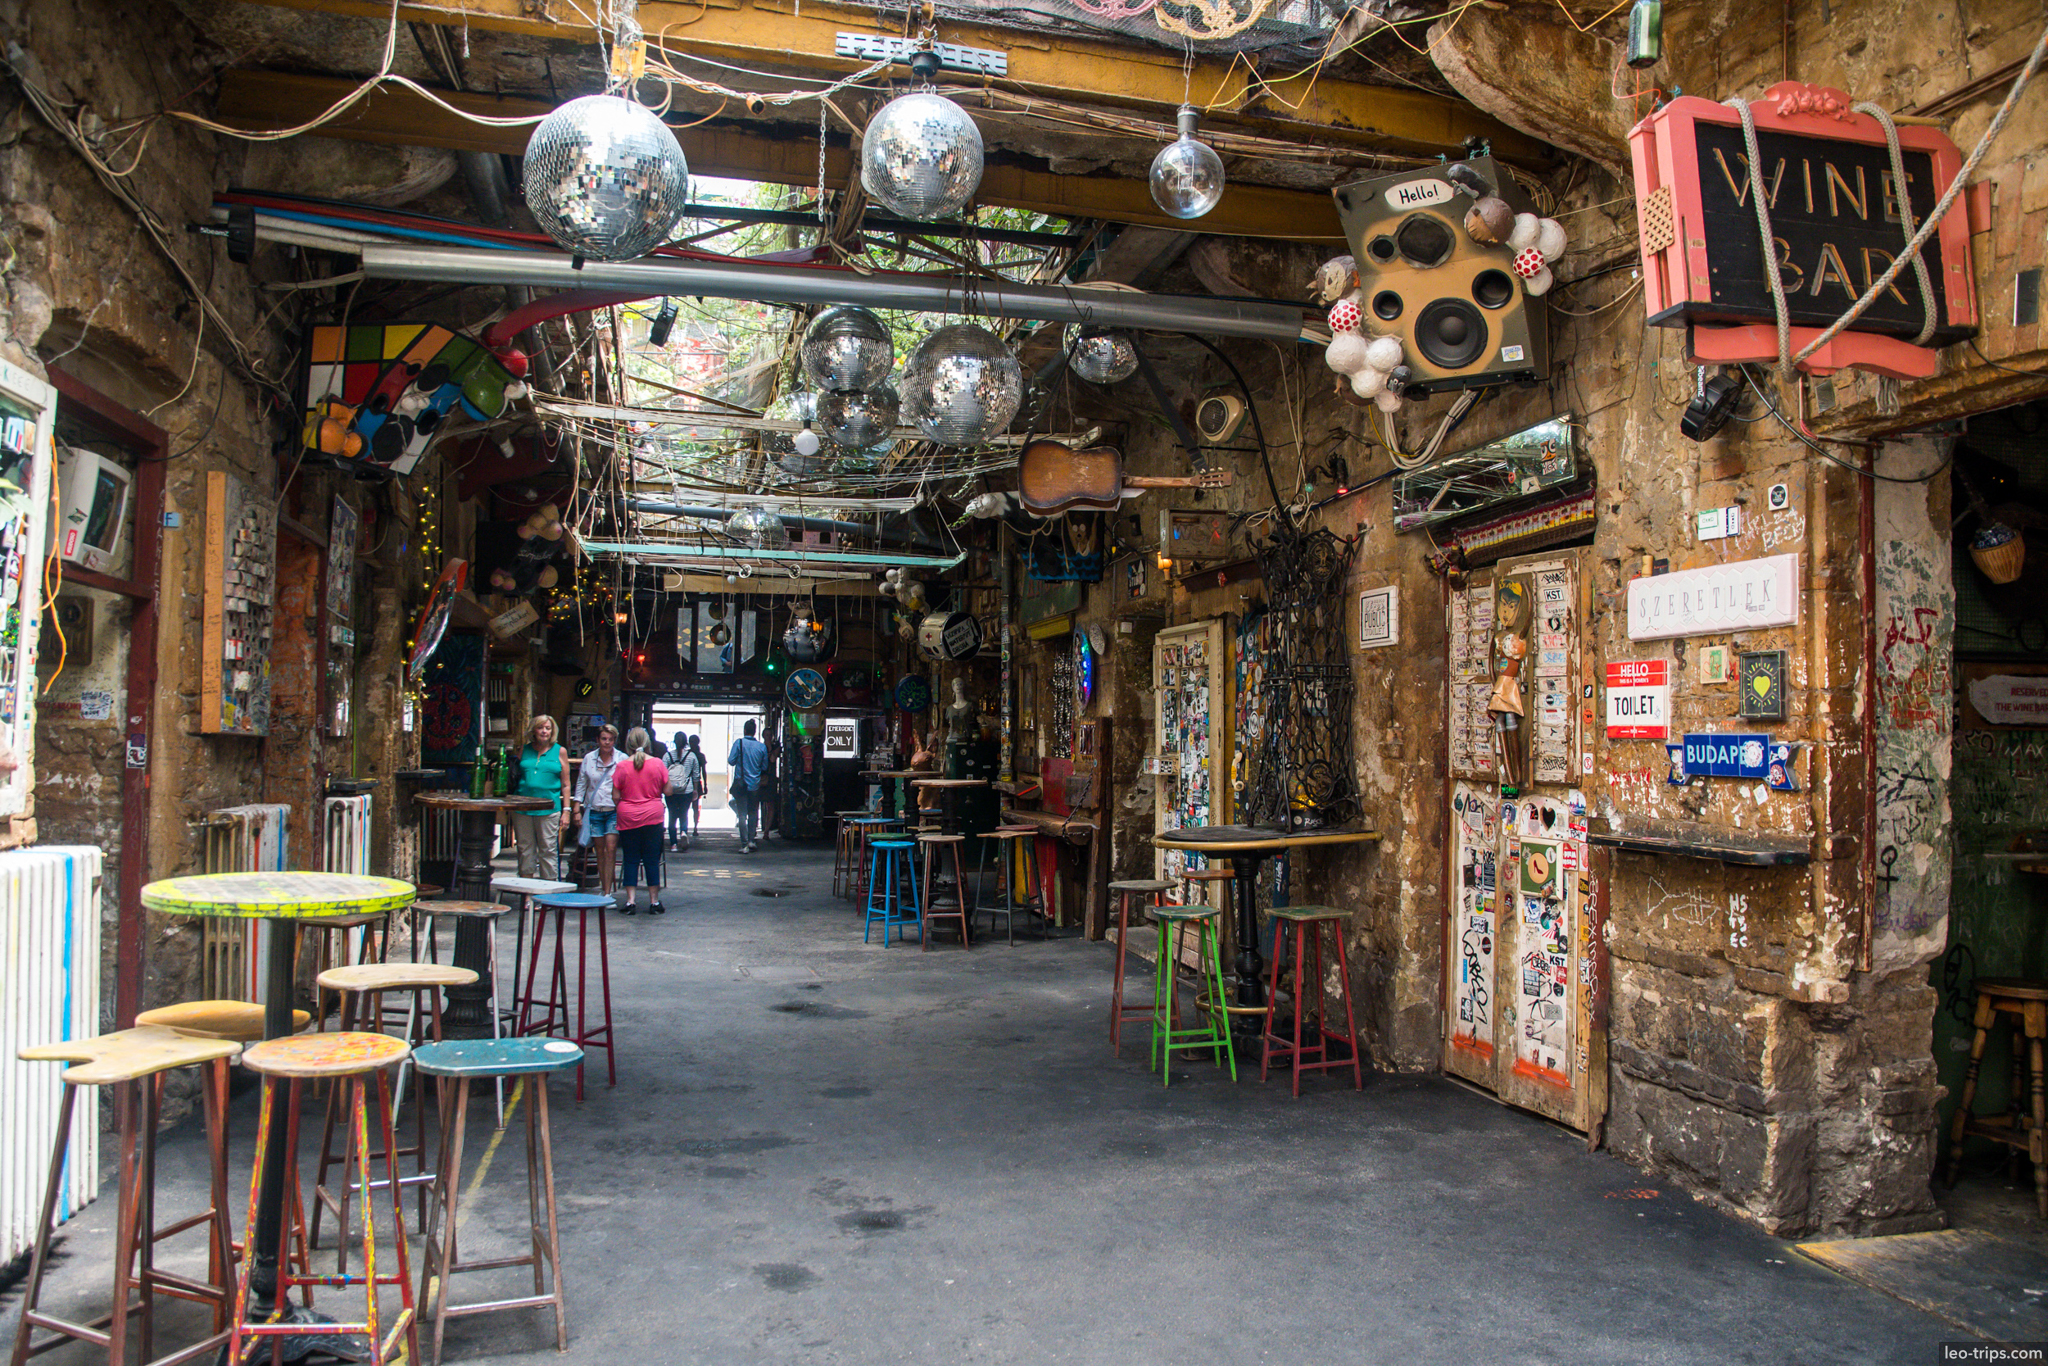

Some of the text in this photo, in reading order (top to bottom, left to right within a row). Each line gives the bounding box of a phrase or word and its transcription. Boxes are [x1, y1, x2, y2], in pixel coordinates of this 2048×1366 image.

[1399, 184, 1439, 205] Hello!
[1713, 147, 1921, 225] WINE
[1759, 236, 1909, 306] BAR
[1546, 590, 1561, 600] KST
[1639, 579, 1771, 619] SZERETLEK
[1620, 663, 1649, 678] HELLO
[1614, 694, 1655, 716] TOILET
[1995, 702, 2011, 712] THE
[2012, 702, 2034, 712] WINE
[827, 736, 852, 746] ONLY
[1686, 744, 1764, 765] BUDAPE
[1549, 955, 1566, 966] KST
